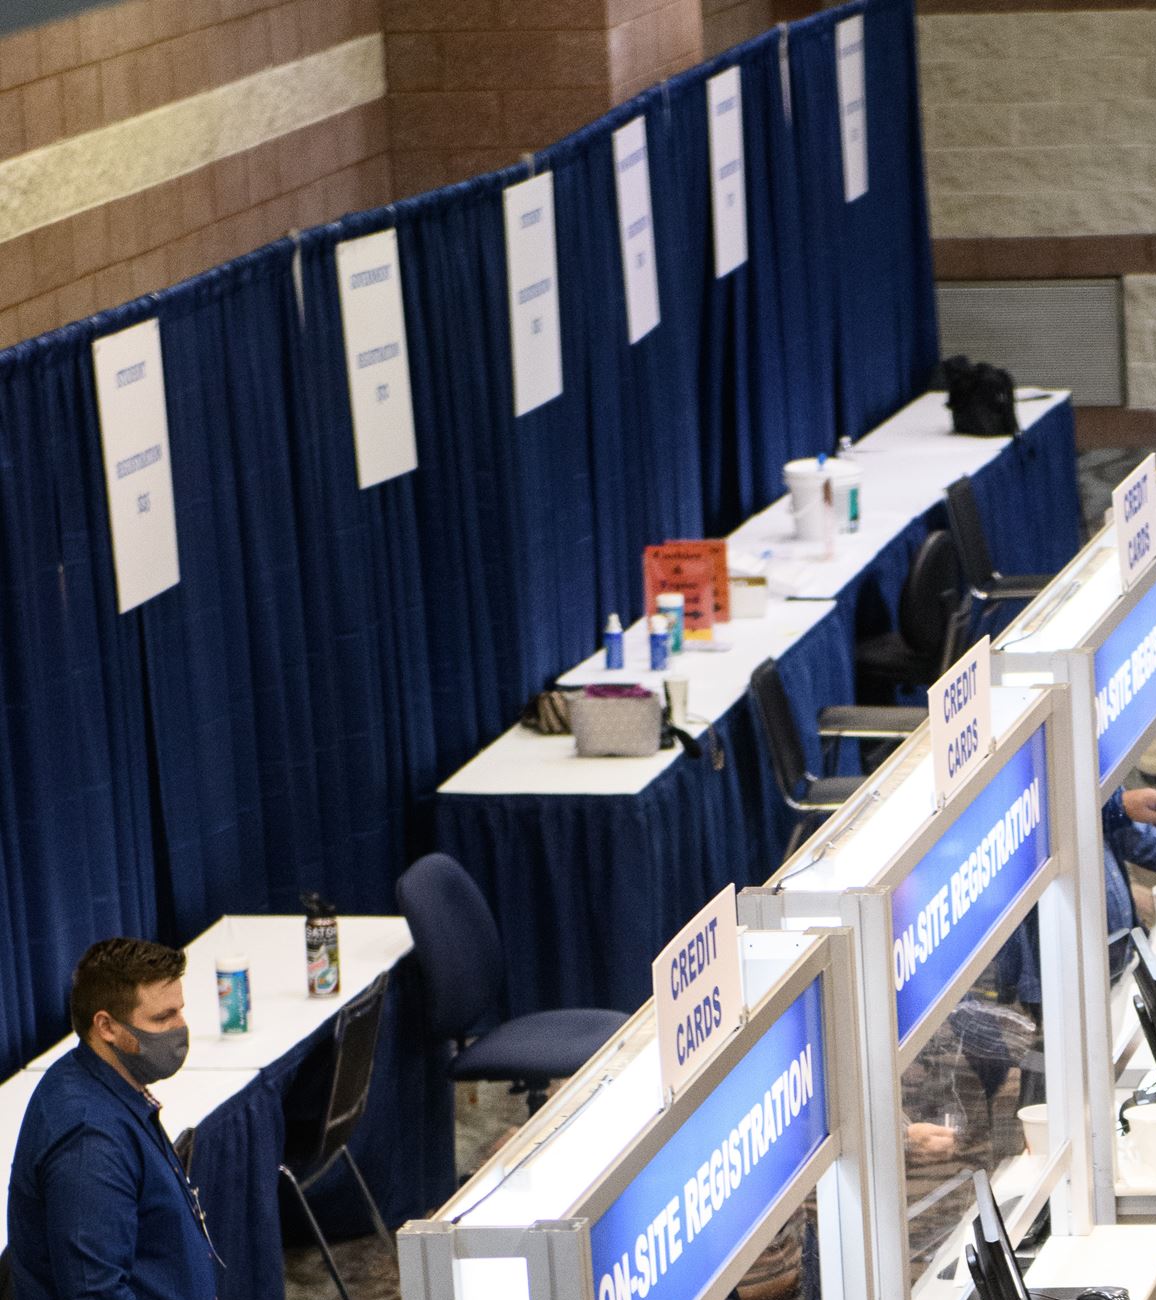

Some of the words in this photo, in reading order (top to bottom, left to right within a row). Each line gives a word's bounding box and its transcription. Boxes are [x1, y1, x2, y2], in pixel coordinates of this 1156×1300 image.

[942, 660, 979, 724] CREDIT
[947, 717, 980, 779] CARDS
[893, 884, 951, 993] ON-SITE
[950, 777, 1040, 926] REGISTRATION
[669, 916, 719, 1001] CREDIT
[675, 986, 723, 1067] CARDS
[683, 1042, 814, 1246] REGISTRATION
